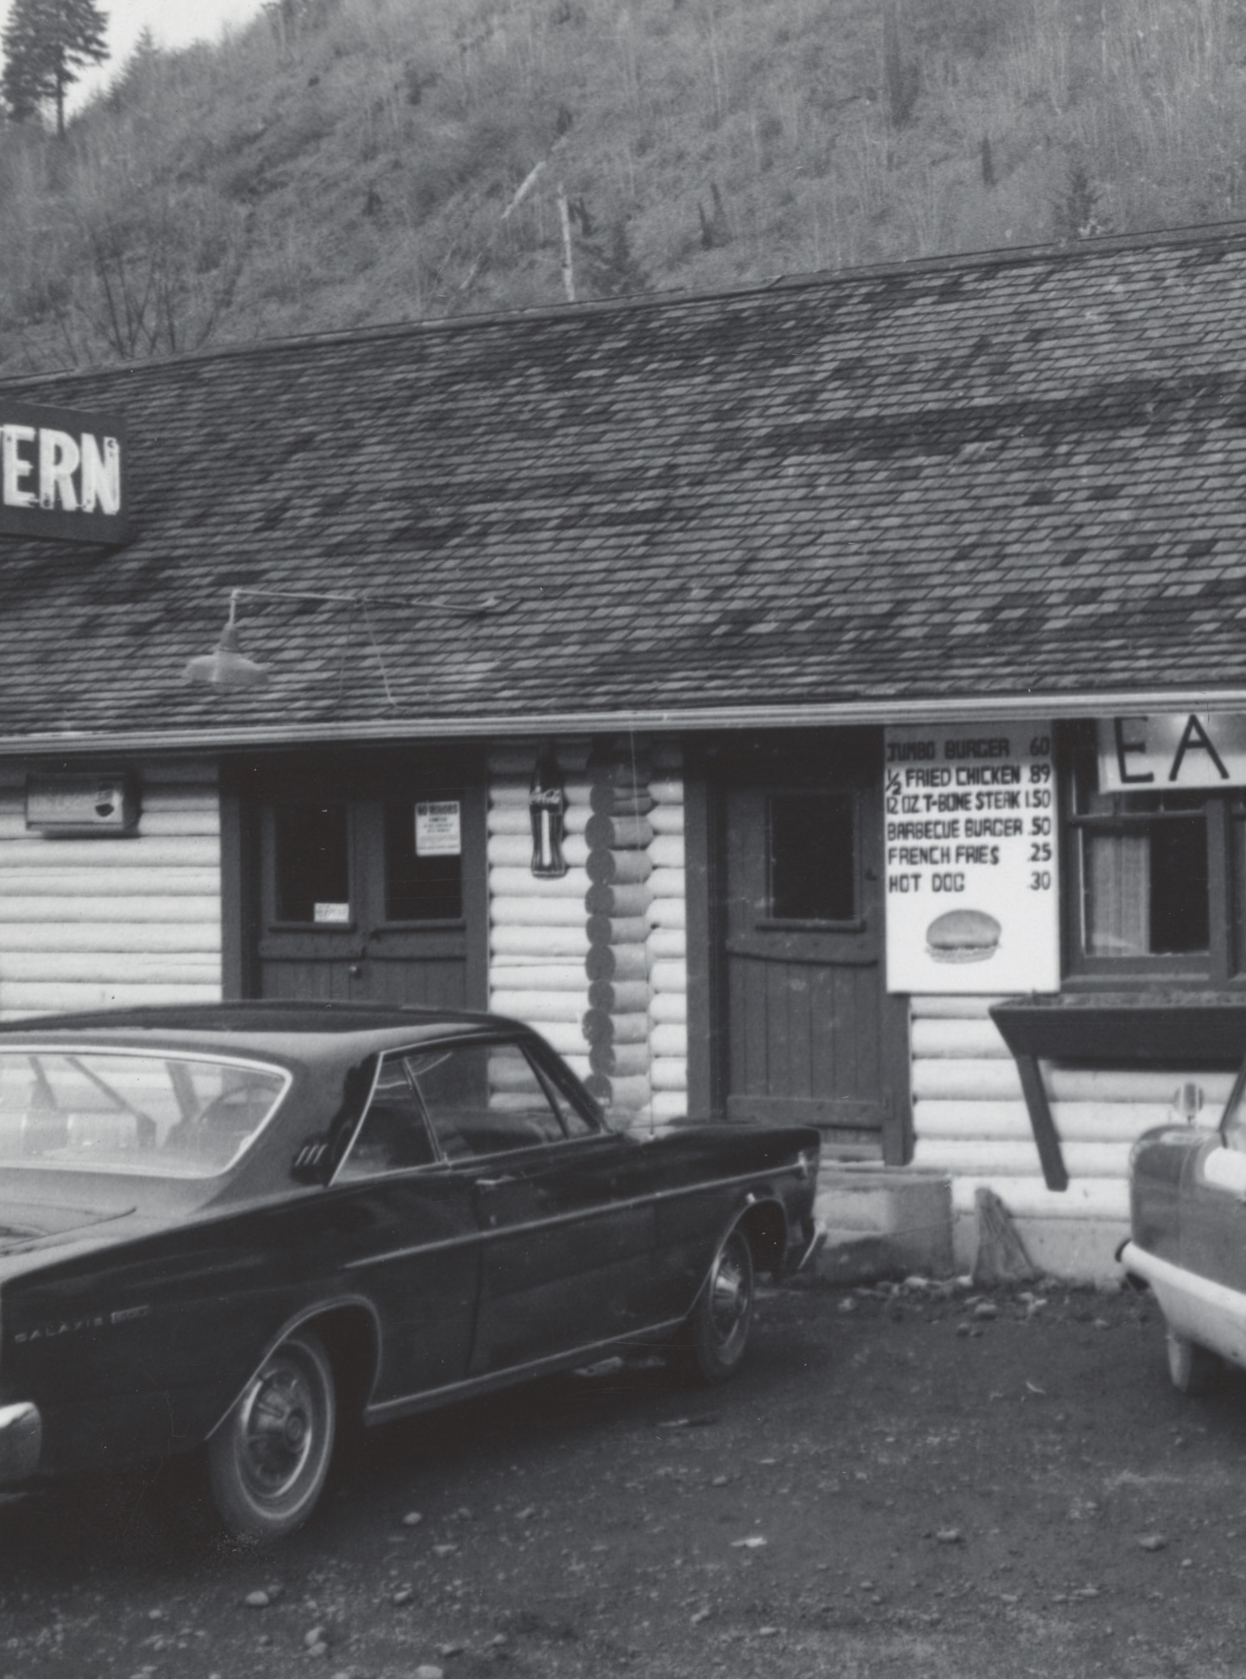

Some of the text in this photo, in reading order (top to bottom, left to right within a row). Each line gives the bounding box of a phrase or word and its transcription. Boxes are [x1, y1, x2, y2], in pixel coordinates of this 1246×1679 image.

[887, 741, 936, 763] JUMBO
[944, 738, 1010, 759] BURGER
[905, 766, 952, 788] FRIED
[956, 765, 1021, 786] CHICKEN
[887, 797, 899, 815] 12
[923, 793, 972, 813] T-BONE
[974, 791, 1021, 811] STEAK
[887, 819, 960, 842] BARBECUE
[964, 818, 1022, 839] BURGER
[888, 846, 951, 866] FRENCH
[955, 844, 1000, 866] FRIES
[888, 874, 922, 893] HOT
[931, 873, 965, 893] DOG
